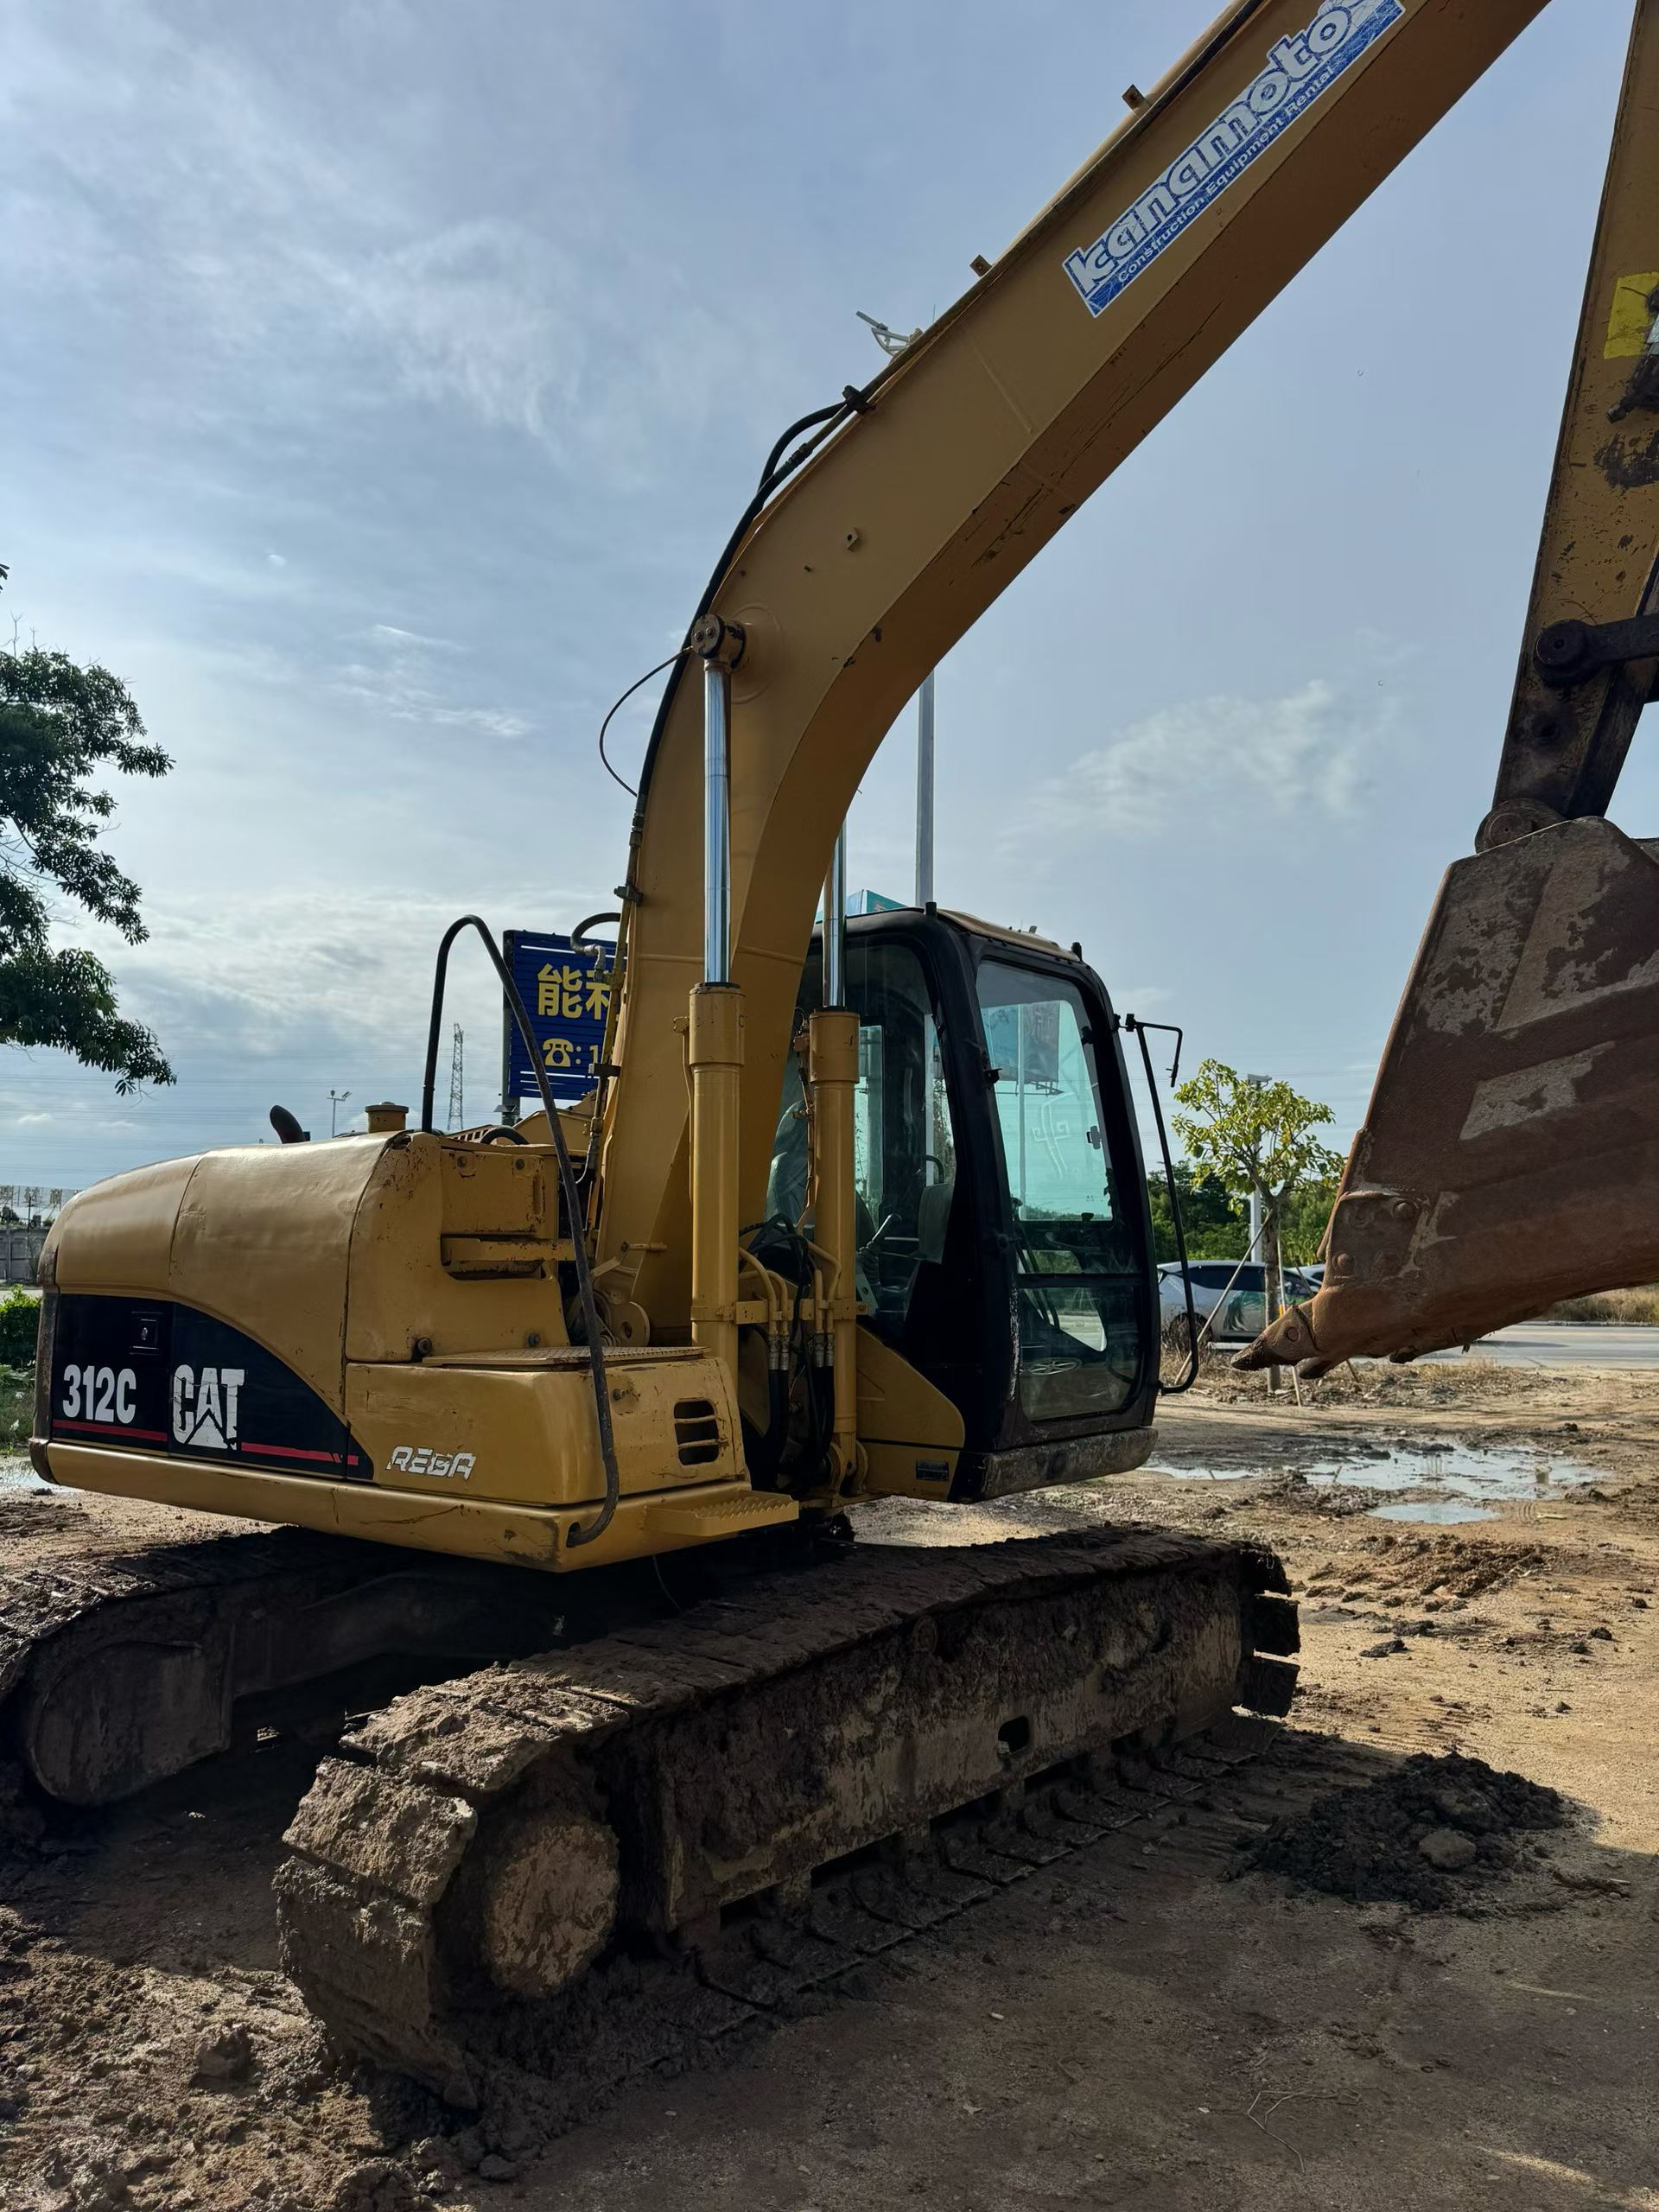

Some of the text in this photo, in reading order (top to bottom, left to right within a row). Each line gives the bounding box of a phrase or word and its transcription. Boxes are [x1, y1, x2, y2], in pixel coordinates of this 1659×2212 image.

[1065, 6, 1352, 296] kanamoto
[1118, 67, 1334, 283] Construction Equipment Rental
[62, 1363, 137, 1424] 312C
[173, 1363, 245, 1450] CAT
